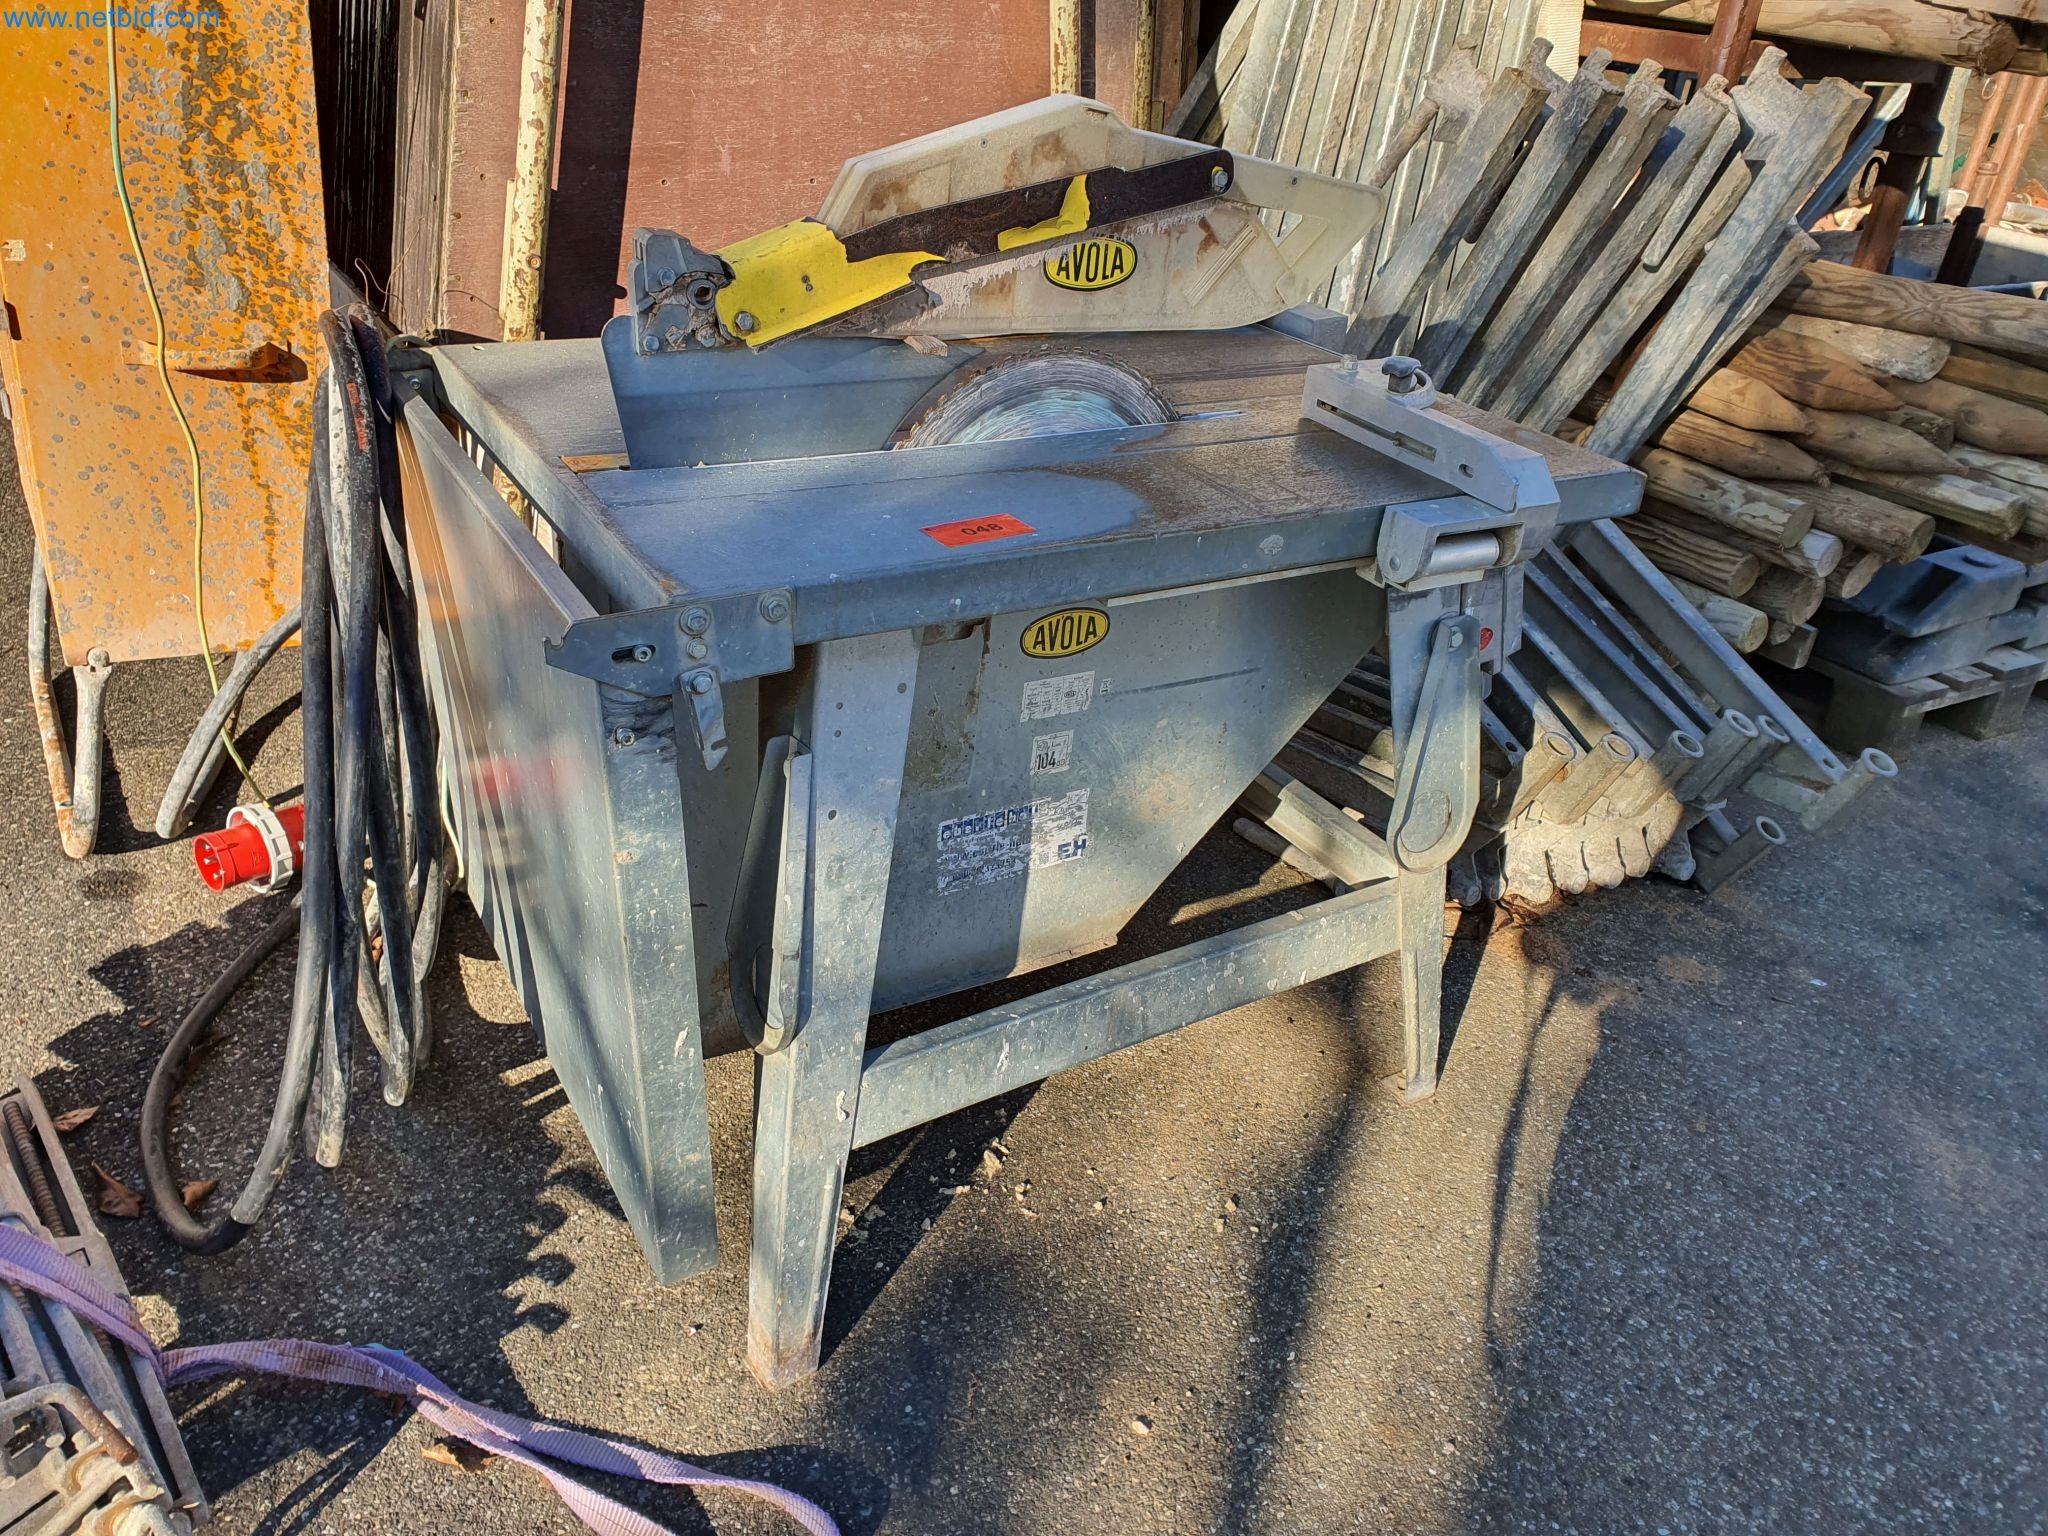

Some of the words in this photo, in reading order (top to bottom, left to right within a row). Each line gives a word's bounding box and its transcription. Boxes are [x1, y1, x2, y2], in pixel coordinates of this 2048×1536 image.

[1056, 241, 1124, 282] AVOLA
[961, 523, 1003, 535] 048
[1033, 615, 1097, 651] AVOLA
[1037, 751, 1056, 770] 104
